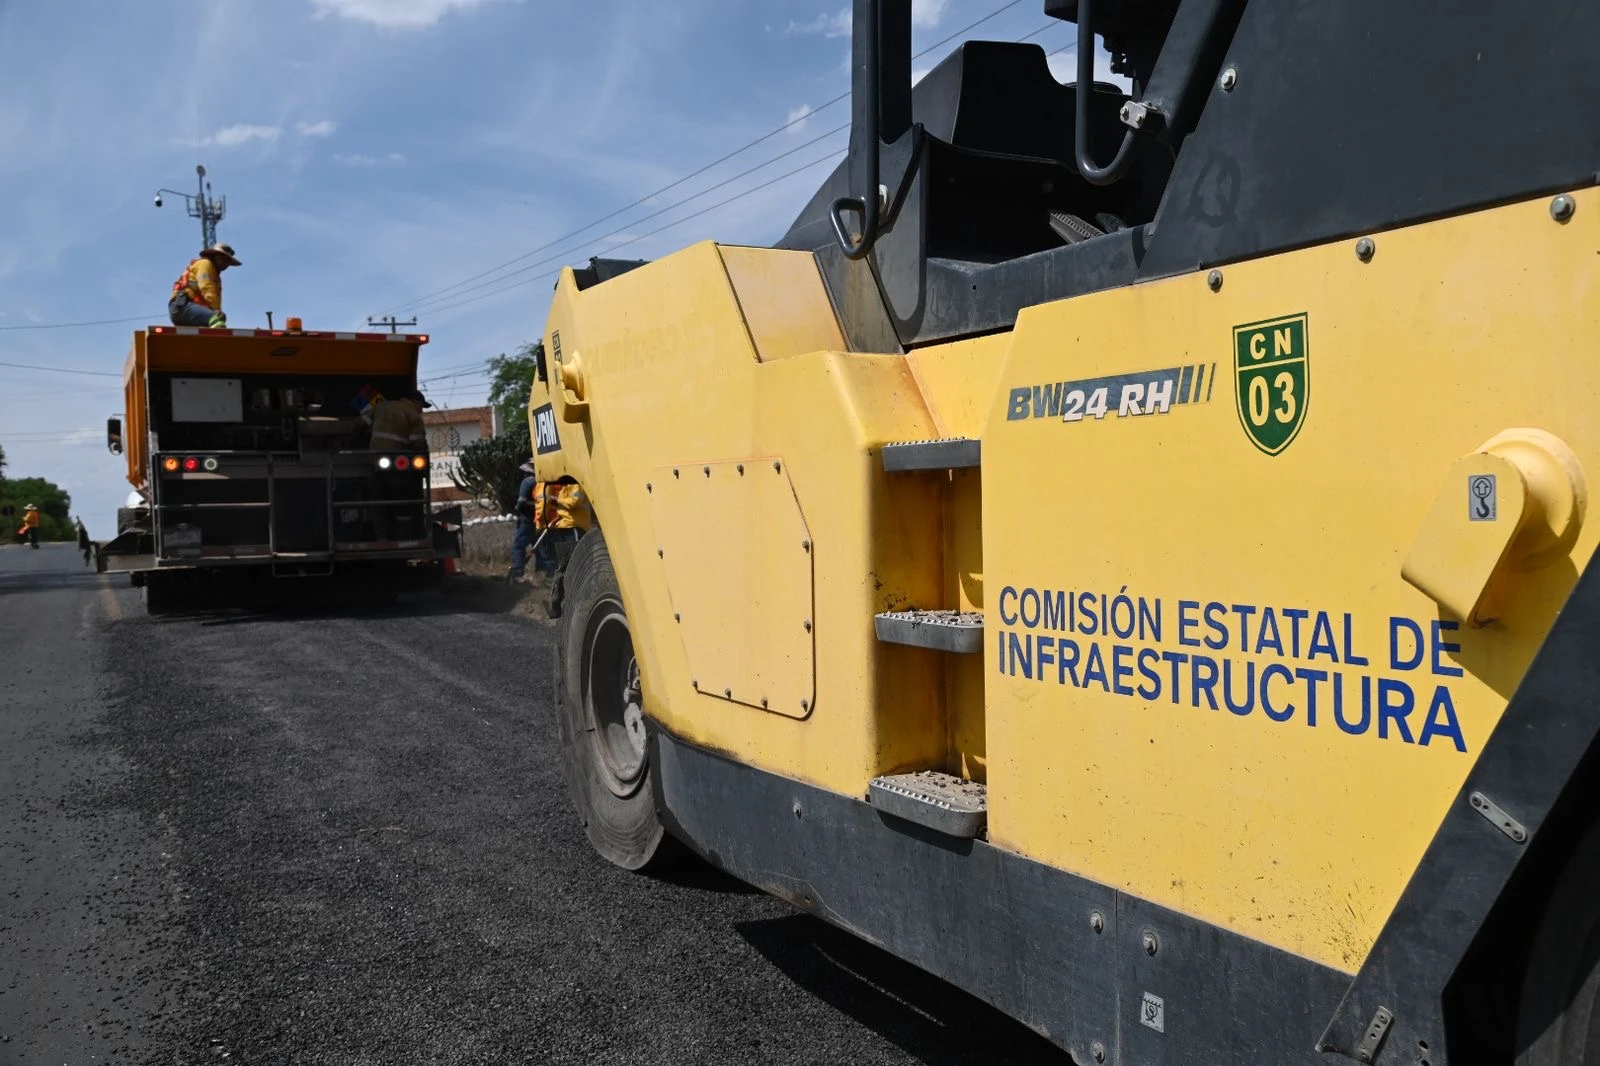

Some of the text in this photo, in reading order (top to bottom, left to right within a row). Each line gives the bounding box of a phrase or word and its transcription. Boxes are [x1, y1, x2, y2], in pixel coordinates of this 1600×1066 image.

[1249, 327, 1292, 361] CN
[1117, 379, 1173, 418] RH
[1248, 371, 1296, 427] 03
[999, 585, 1465, 678] COMISIÓN ESTATAL DE
[998, 630, 1469, 753] INFRAESTRUCTURA
